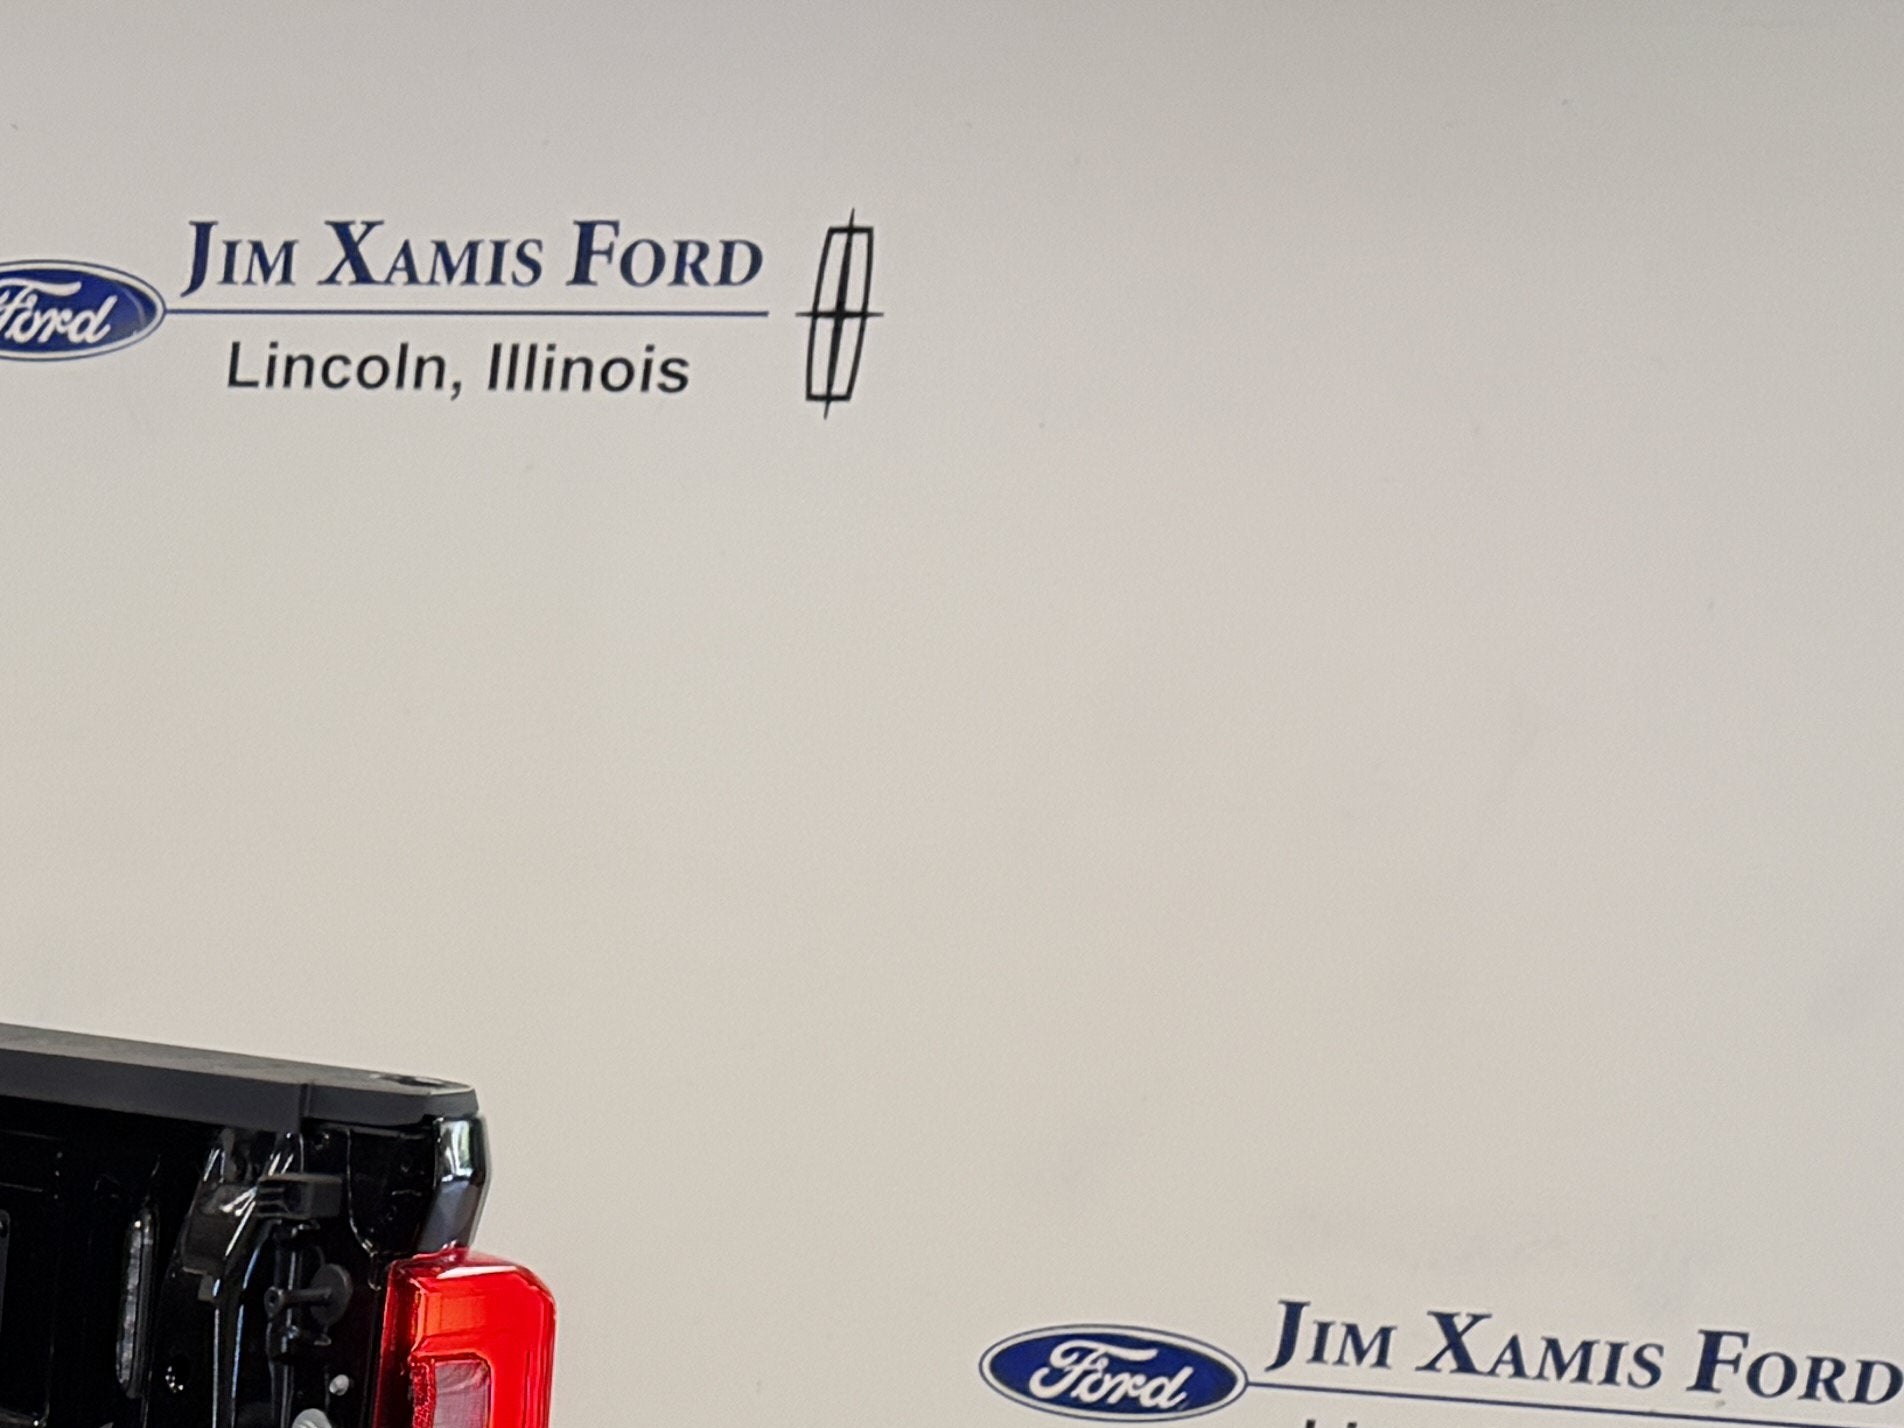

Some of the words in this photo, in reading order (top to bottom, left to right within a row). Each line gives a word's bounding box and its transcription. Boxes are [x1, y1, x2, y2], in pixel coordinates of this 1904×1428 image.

[180, 219, 299, 298] JIM
[317, 219, 543, 288] XAMIS
[566, 219, 764, 288] FORD
[227, 341, 462, 401] Lincoln,
[487, 342, 690, 394] Illinois
[1028, 1339, 1194, 1409] Ford
[1265, 1299, 1396, 1372] JIM
[1414, 1311, 1664, 1389] XAMIS
[1685, 1328, 1904, 1406] FORD
